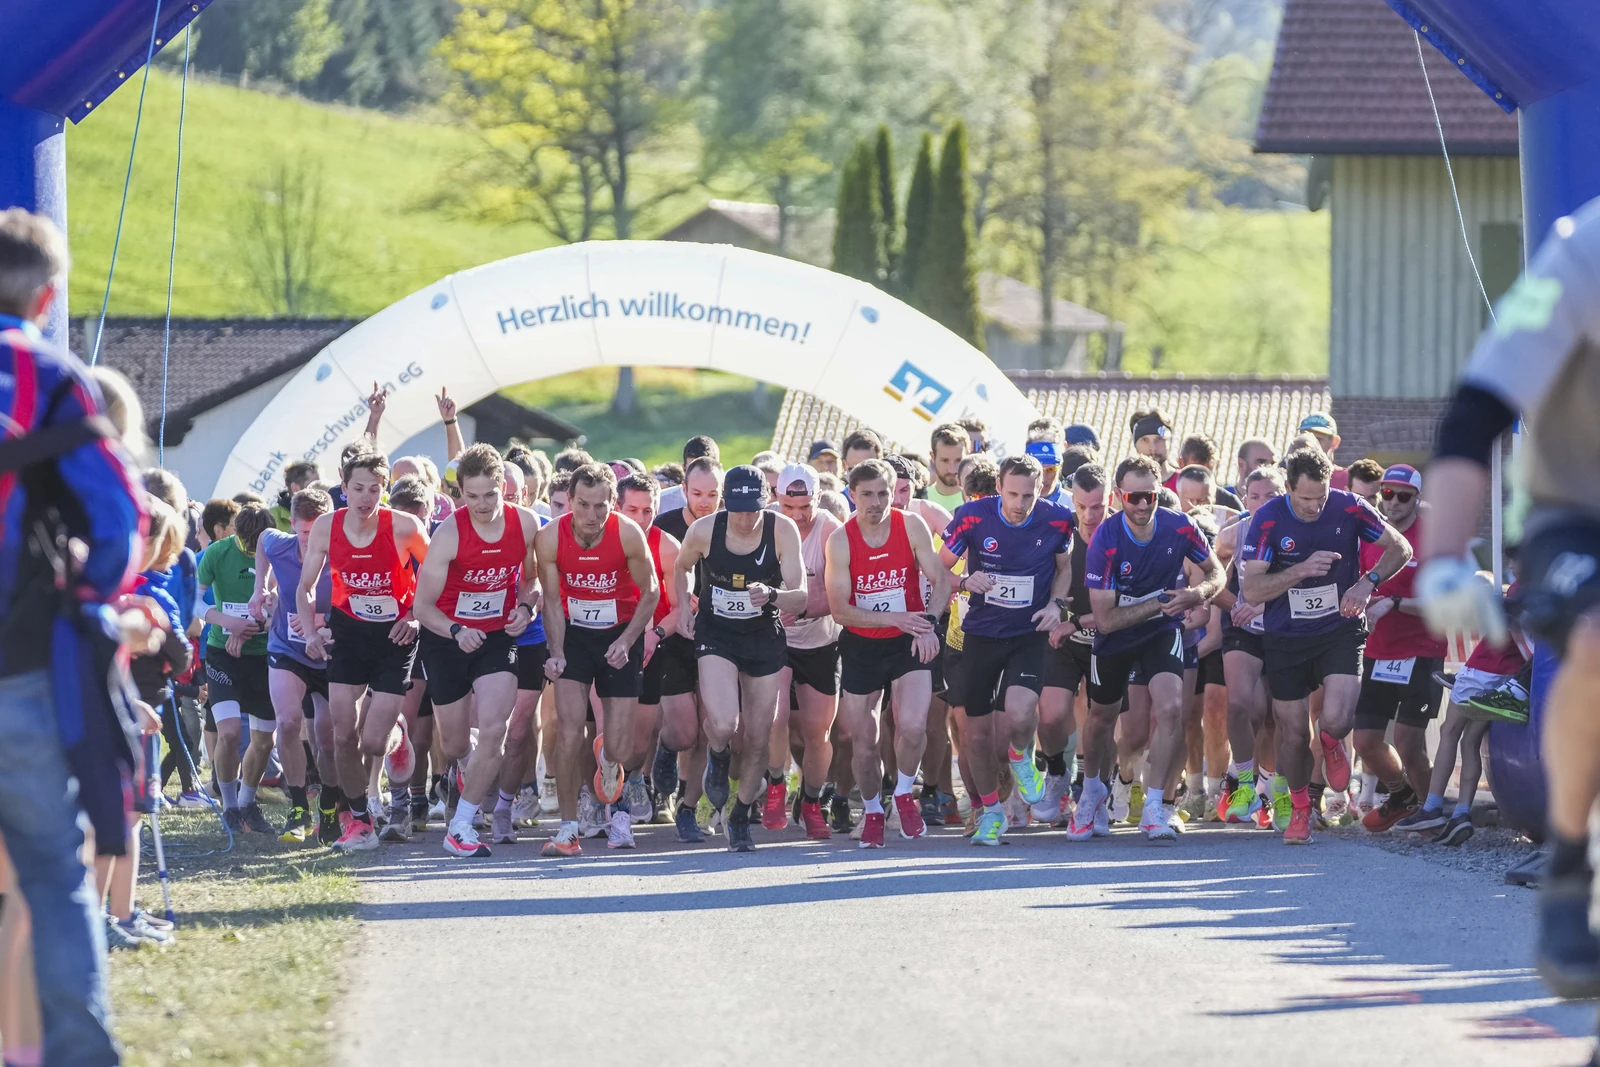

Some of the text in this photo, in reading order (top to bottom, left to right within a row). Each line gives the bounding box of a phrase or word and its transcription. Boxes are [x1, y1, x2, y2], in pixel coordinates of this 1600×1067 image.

[497, 291, 811, 345] Herzlich willkommen!
[399, 361, 424, 385] eG
[248, 450, 287, 494] bank
[341, 571, 392, 580] SPORT
[466, 565, 516, 577] SPORT
[566, 570, 618, 581] SPORT
[857, 567, 908, 584] SPORT
[856, 577, 906, 590] HASCHKO
[1000, 586, 1016, 599] 21
[365, 603, 383, 615] 38
[472, 600, 490, 612] 24
[727, 600, 745, 612] 28
[872, 602, 890, 612] 42
[1305, 597, 1324, 610] 32
[582, 609, 601, 620] 77
[1386, 660, 1402, 673] 44
